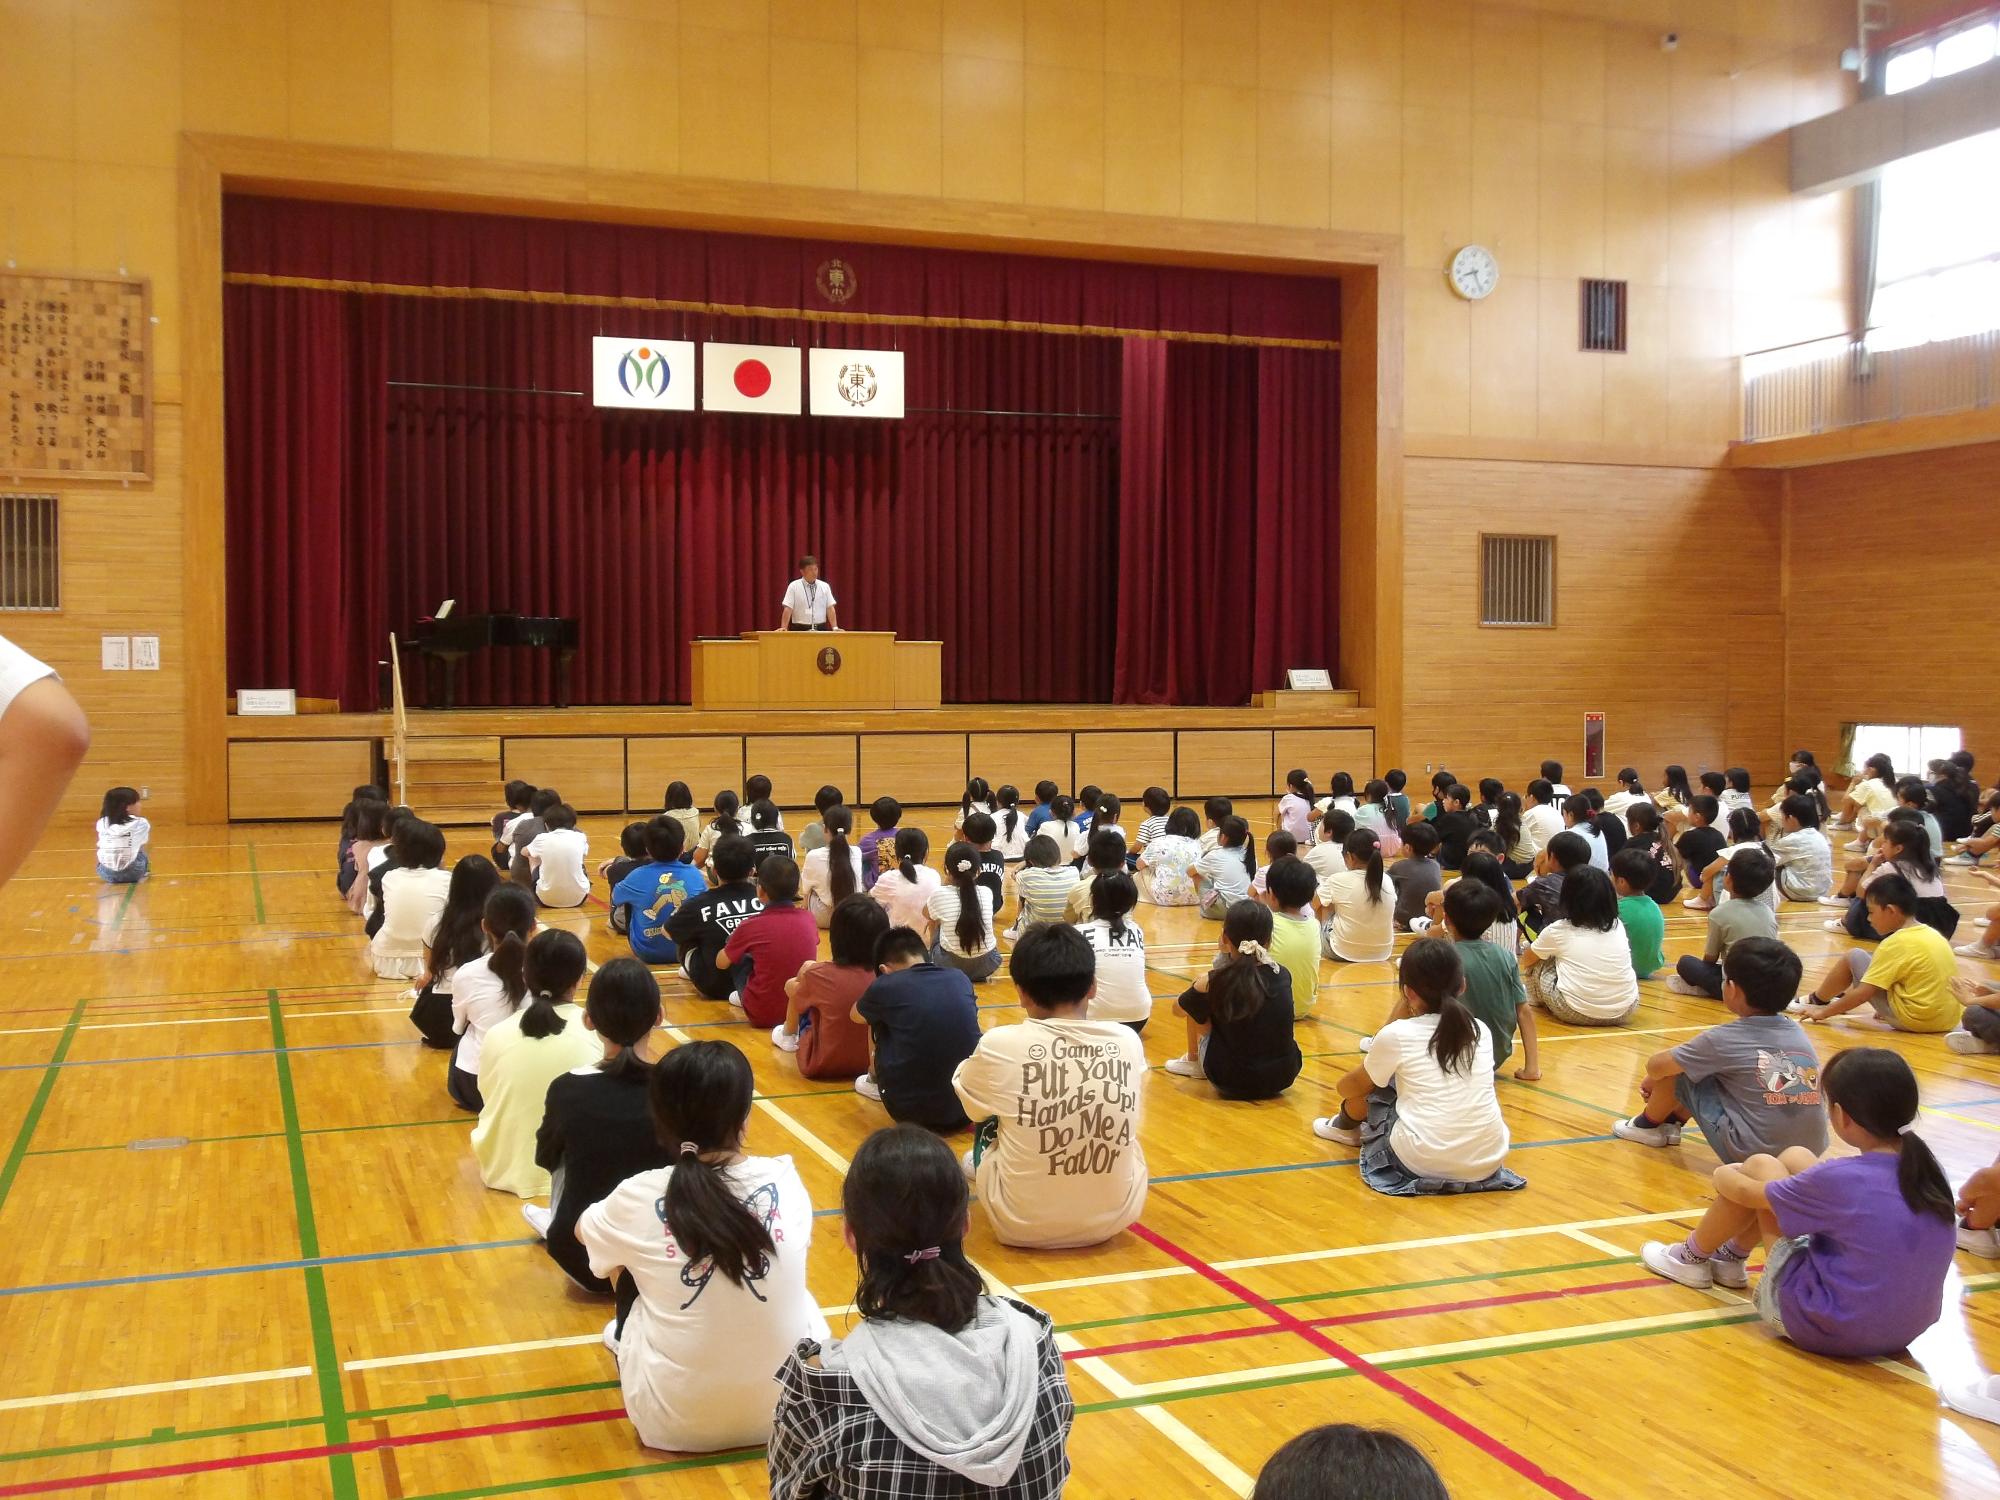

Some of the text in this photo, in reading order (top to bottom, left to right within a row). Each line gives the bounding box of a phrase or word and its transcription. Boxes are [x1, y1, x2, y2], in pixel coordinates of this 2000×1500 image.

[849, 363, 866, 400] 北東小
[1052, 1037, 1104, 1060] Game
[1075, 1056, 1131, 1087] Your
[1017, 1081, 1136, 1127] Hands Up!
[1039, 1103, 1130, 1154] Do Me A
